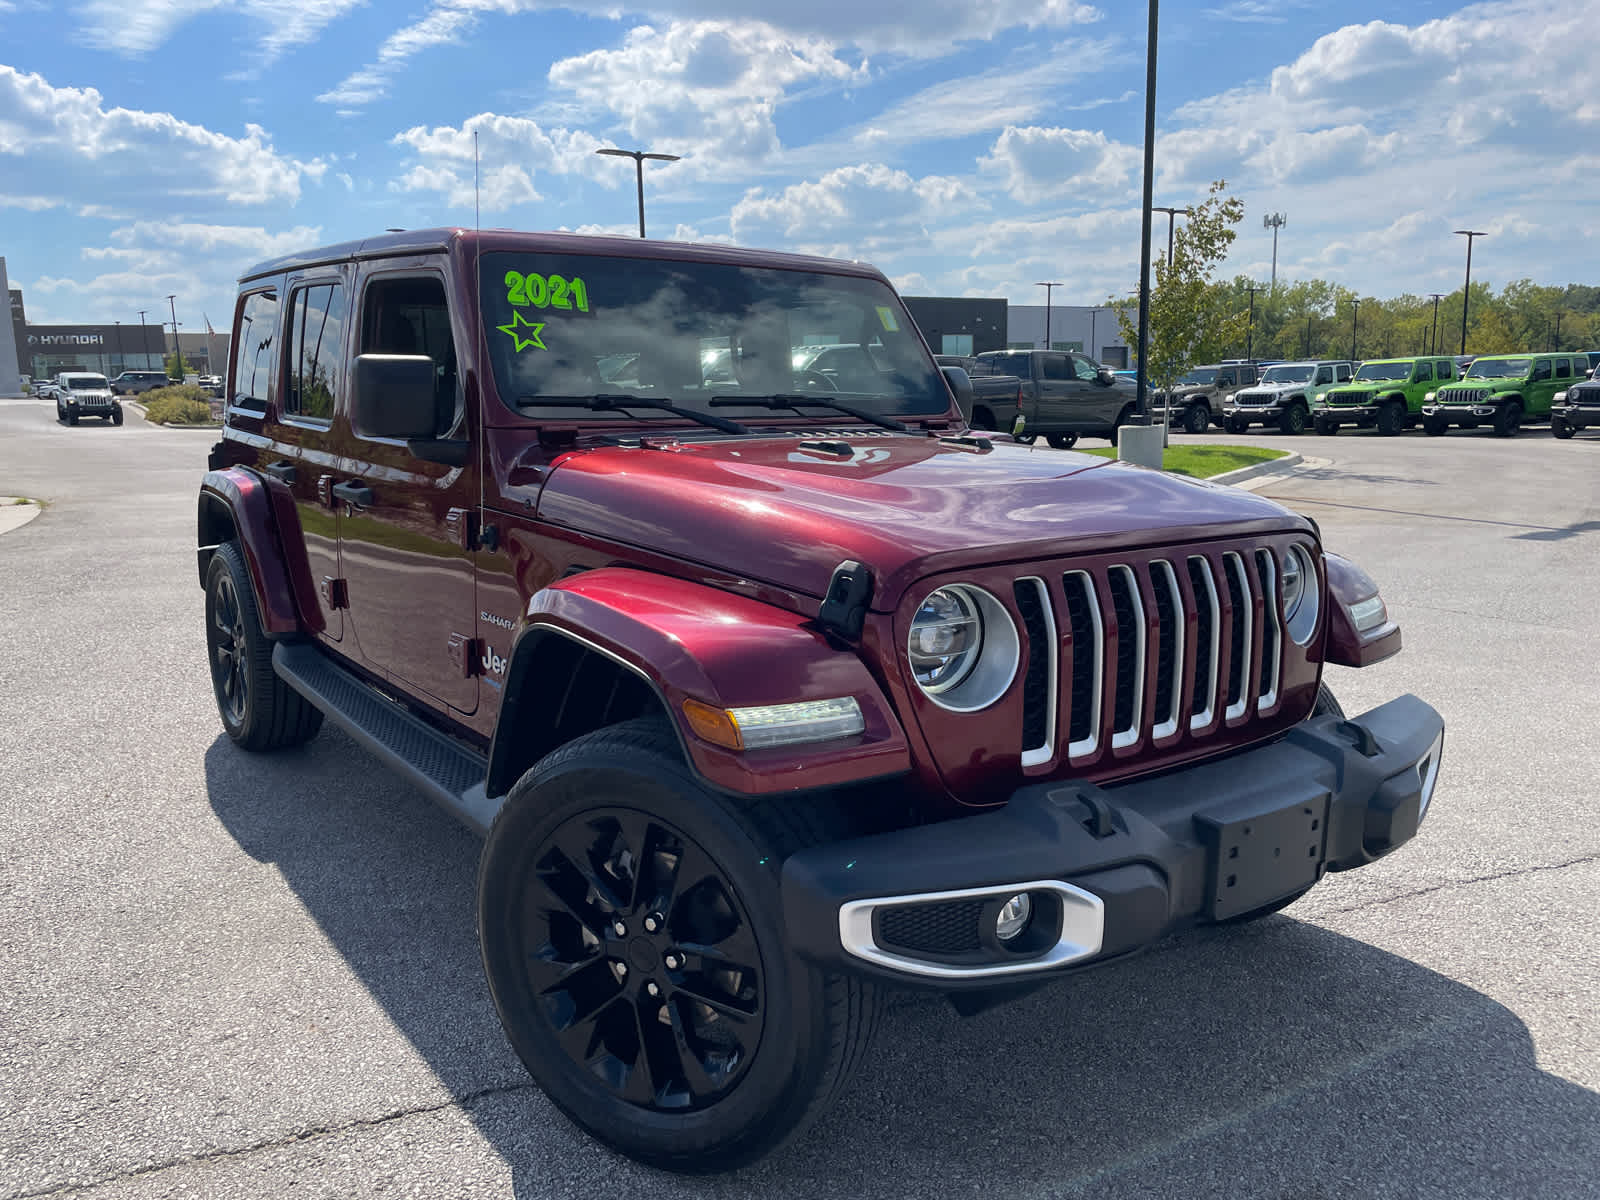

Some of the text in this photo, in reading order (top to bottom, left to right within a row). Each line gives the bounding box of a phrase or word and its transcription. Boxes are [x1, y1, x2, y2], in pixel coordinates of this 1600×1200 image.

[504, 270, 589, 312] 2021
[40, 335, 104, 345] HYUNDAI
[482, 646, 507, 675] Jee
